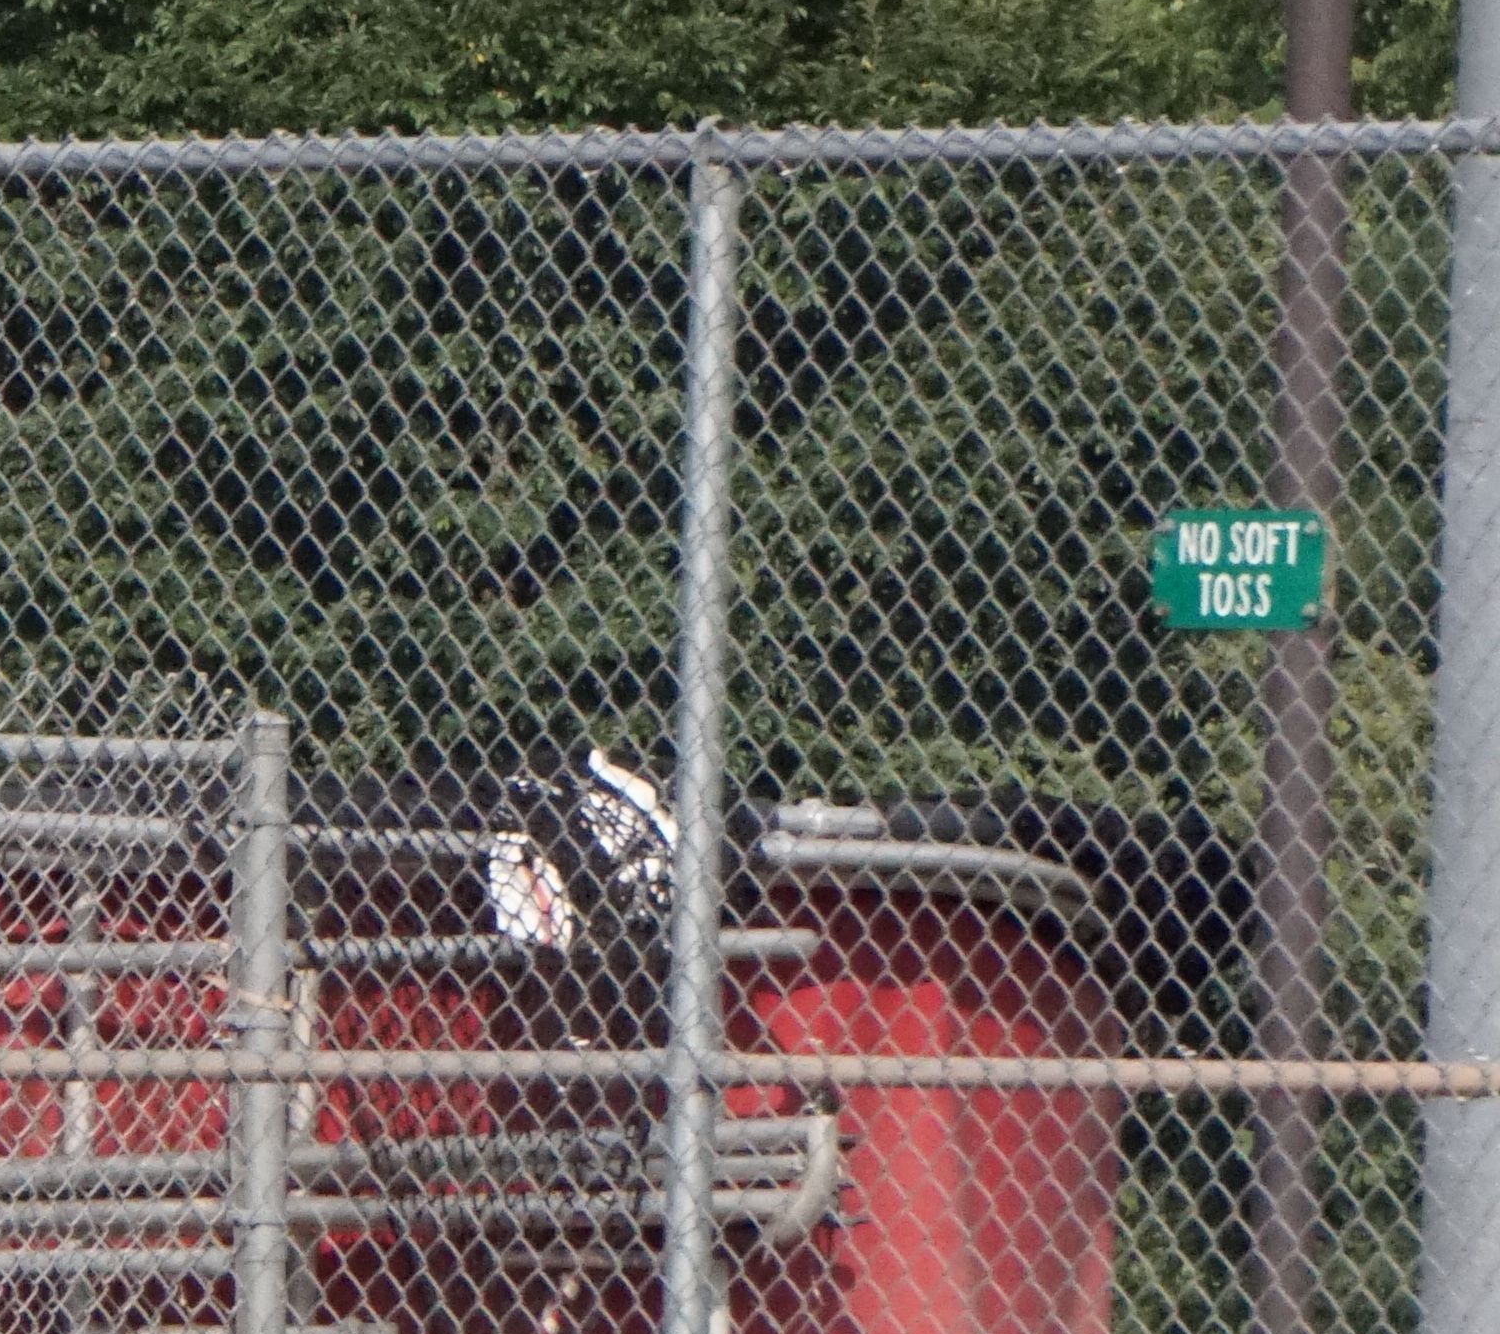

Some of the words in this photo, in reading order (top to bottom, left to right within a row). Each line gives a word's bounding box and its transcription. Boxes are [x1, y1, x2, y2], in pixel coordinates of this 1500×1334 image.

[1178, 521, 1220, 566] NO
[1228, 521, 1300, 566] SOFT
[1198, 572, 1272, 617] TOSS
